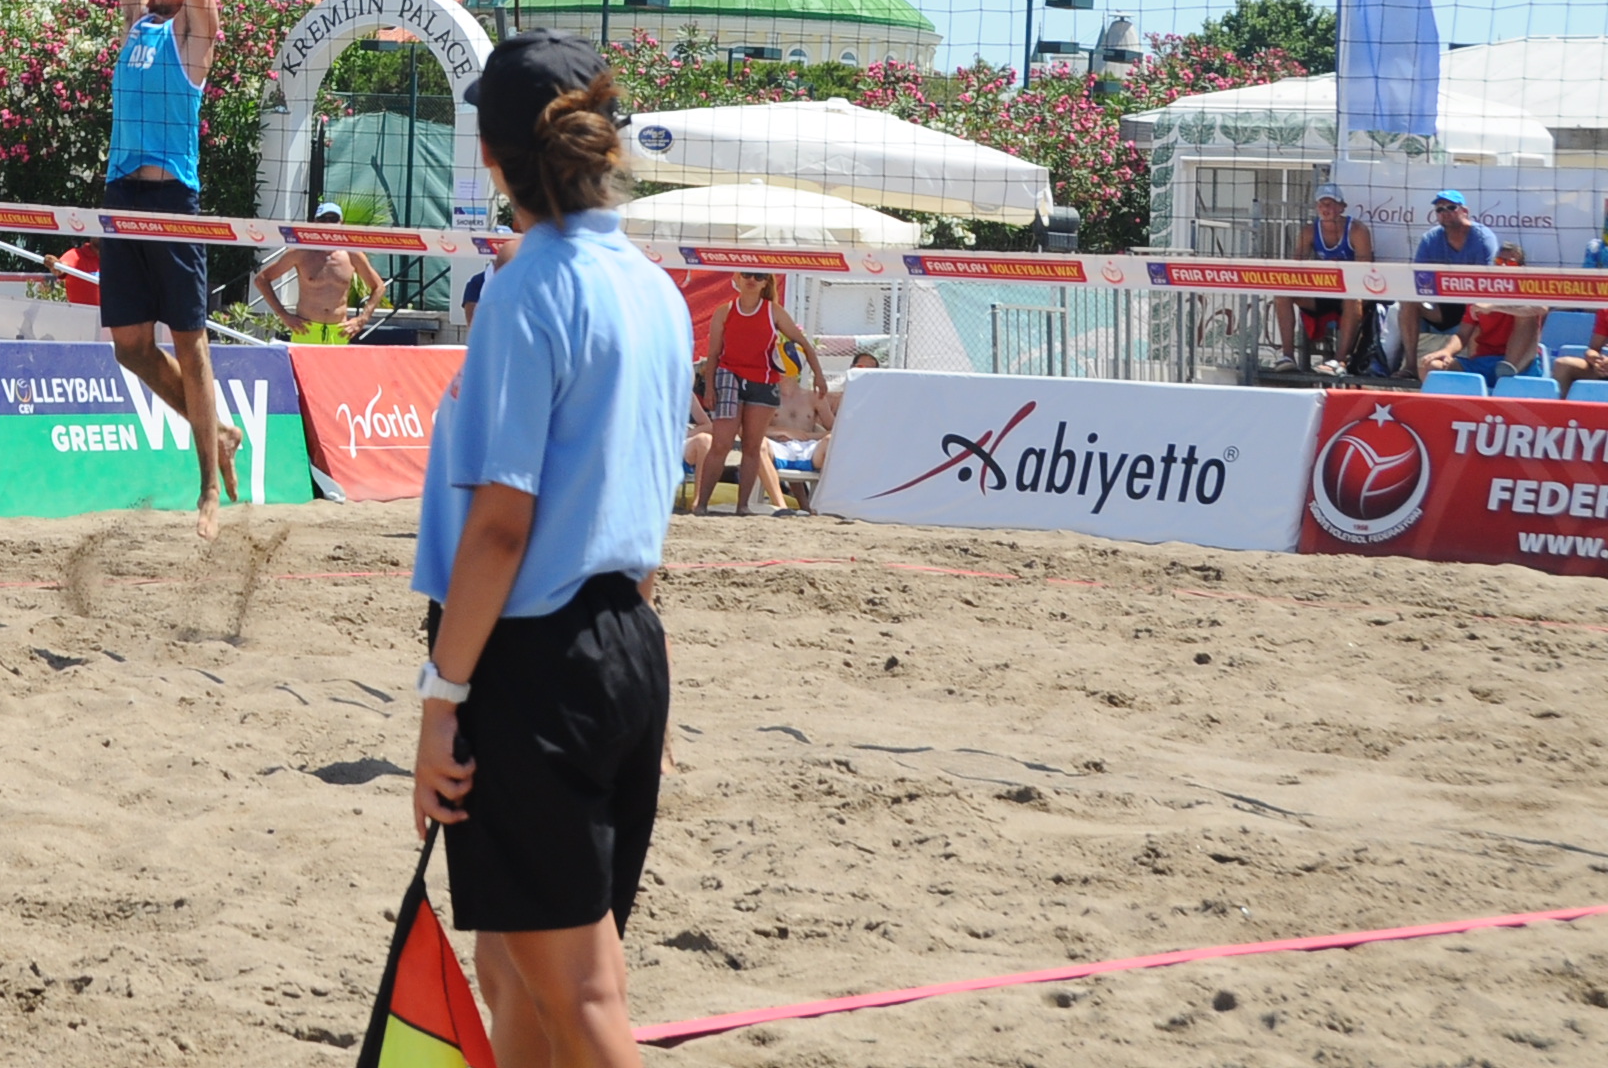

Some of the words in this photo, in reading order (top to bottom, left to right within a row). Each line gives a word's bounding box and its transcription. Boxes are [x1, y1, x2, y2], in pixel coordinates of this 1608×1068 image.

[1354, 196, 1414, 224] World
[701, 252, 728, 262] FAIR
[730, 253, 759, 263] PLAY
[760, 255, 818, 266] VOLLEYBALL
[820, 257, 841, 266] WAY
[926, 261, 955, 272] FAIR
[958, 262, 989, 273] PLAY
[990, 264, 1054, 276] VOLLEYBALL
[1056, 266, 1079, 277] WAY
[1172, 268, 1204, 281] FAIR
[1206, 270, 1238, 282] PLAY
[1241, 272, 1311, 286] VOLLEYBALL
[1312, 274, 1338, 287] WAY
[1441, 277, 1476, 292] FAIR
[1478, 278, 1514, 292] PLAY
[1518, 279, 1593, 295] VOLLEYBALL
[0, 377, 125, 404] VOLLEYBALL
[19, 404, 34, 414] CEV
[114, 342, 268, 505] WY
[336, 385, 424, 459] World
[51, 424, 138, 452] GREEN
